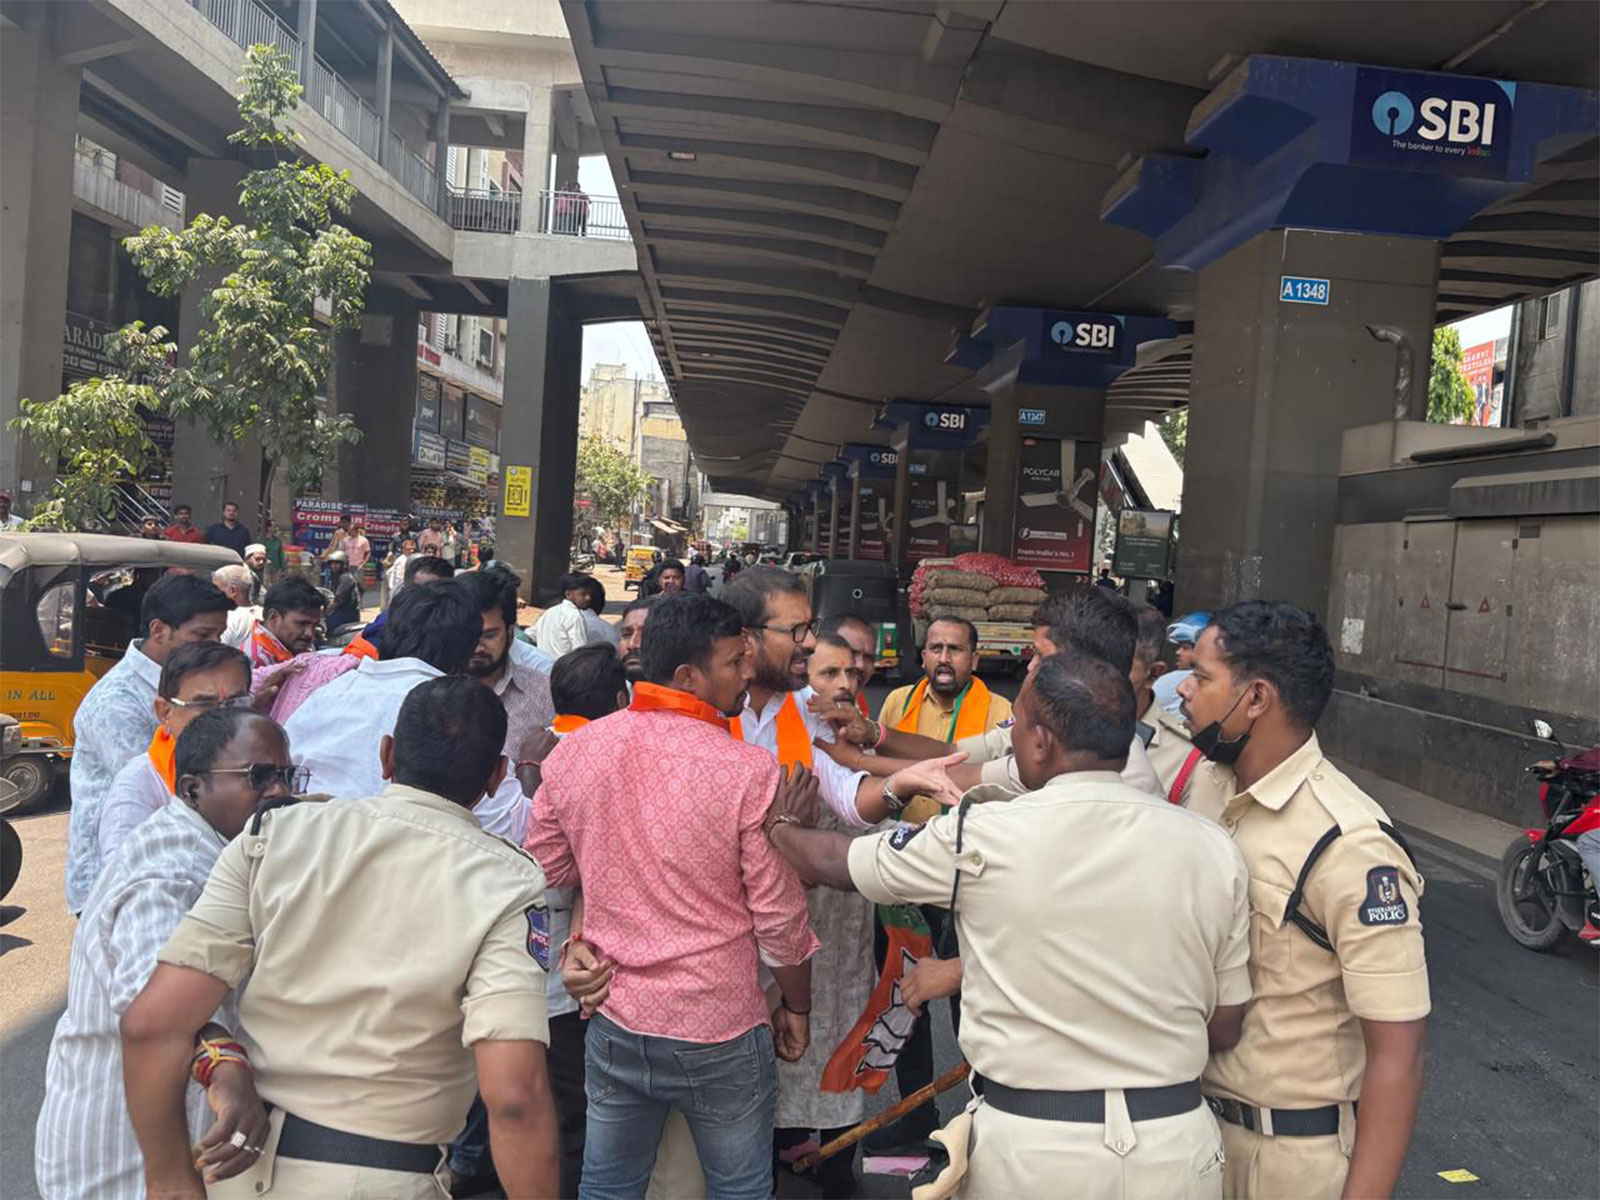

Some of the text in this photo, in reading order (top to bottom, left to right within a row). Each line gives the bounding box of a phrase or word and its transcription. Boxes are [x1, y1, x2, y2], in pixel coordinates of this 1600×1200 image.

[1418, 97, 1495, 145] SBI
[1392, 140, 1406, 149] The
[1408, 141, 1434, 152] banker
[1435, 145, 1443, 153] to
[1444, 146, 1465, 156] every
[1283, 281, 1326, 299] A 1348
[1075, 322, 1115, 348] SBI
[939, 412, 965, 429] SBI
[1023, 467, 1060, 477] POLYCAB
[296, 500, 342, 510] PARADISE
[297, 511, 363, 525] Crompn
[421, 507, 464, 518] PARAMOUNT
[8, 689, 56, 701] IN ALL
[1367, 908, 1406, 922] POLIC
